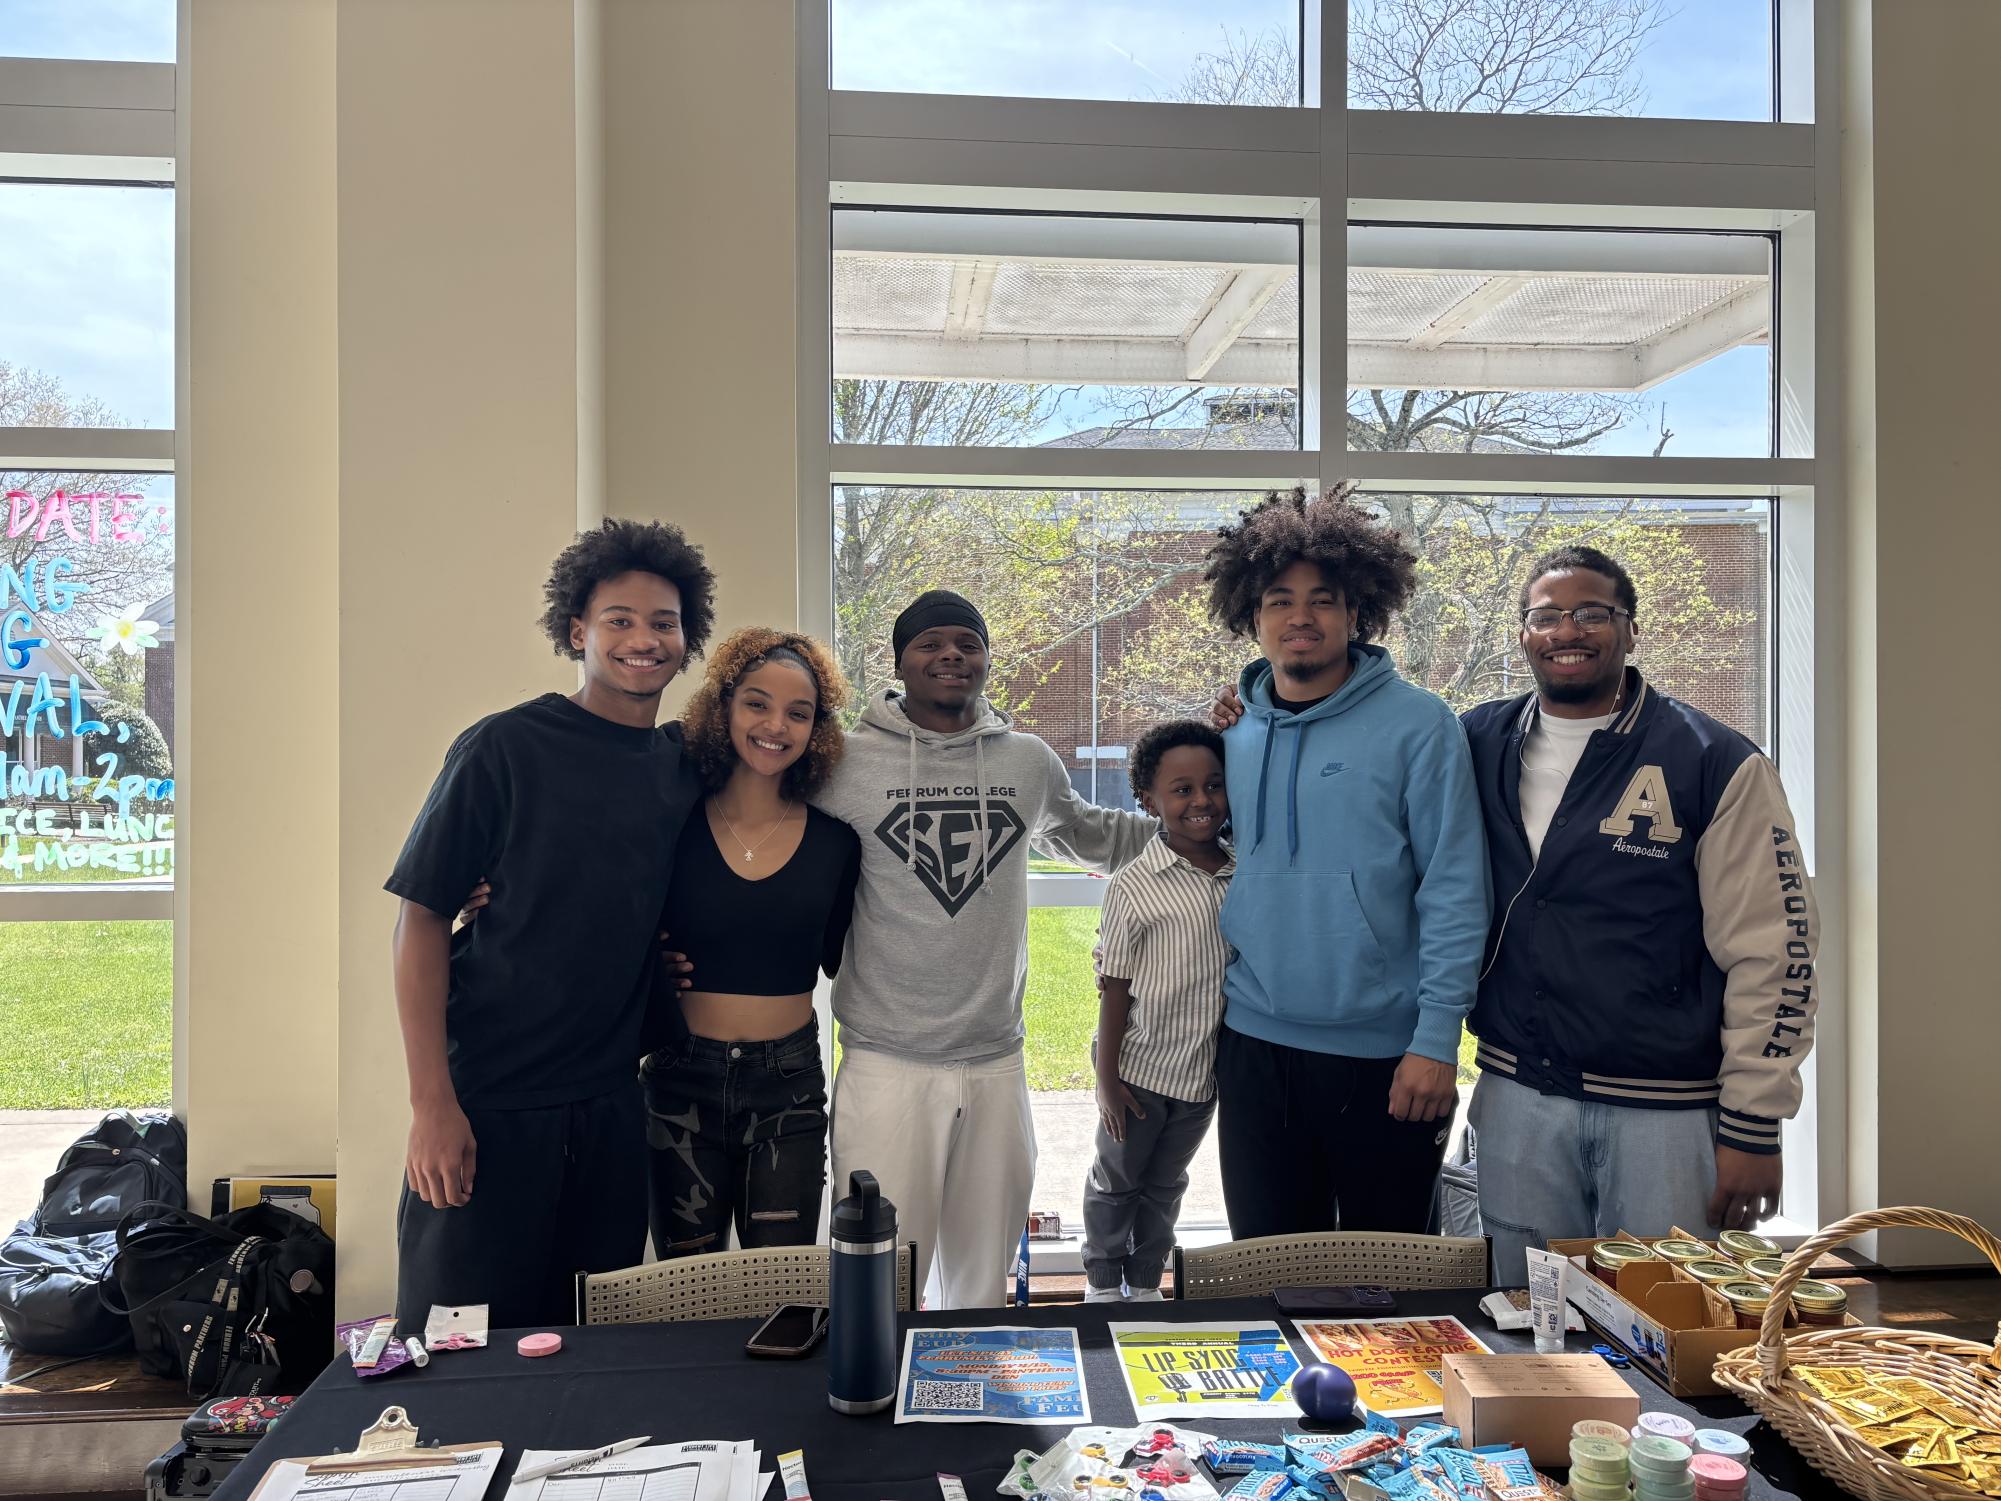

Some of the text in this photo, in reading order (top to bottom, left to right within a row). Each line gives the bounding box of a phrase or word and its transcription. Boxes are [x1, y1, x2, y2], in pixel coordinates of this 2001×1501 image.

[953, 786, 1016, 797] COLEGE
[1599, 765, 1683, 843] A
[1017, 1259, 1028, 1282] NIKE
[1142, 1351, 1177, 1373] LIP
[1182, 1349, 1247, 1371] SYNC
[1328, 1342, 1478, 1358] HOT DOG EATING
[1197, 1367, 1286, 1391] BATTLE
[1501, 1489, 1534, 1499] QUEST
